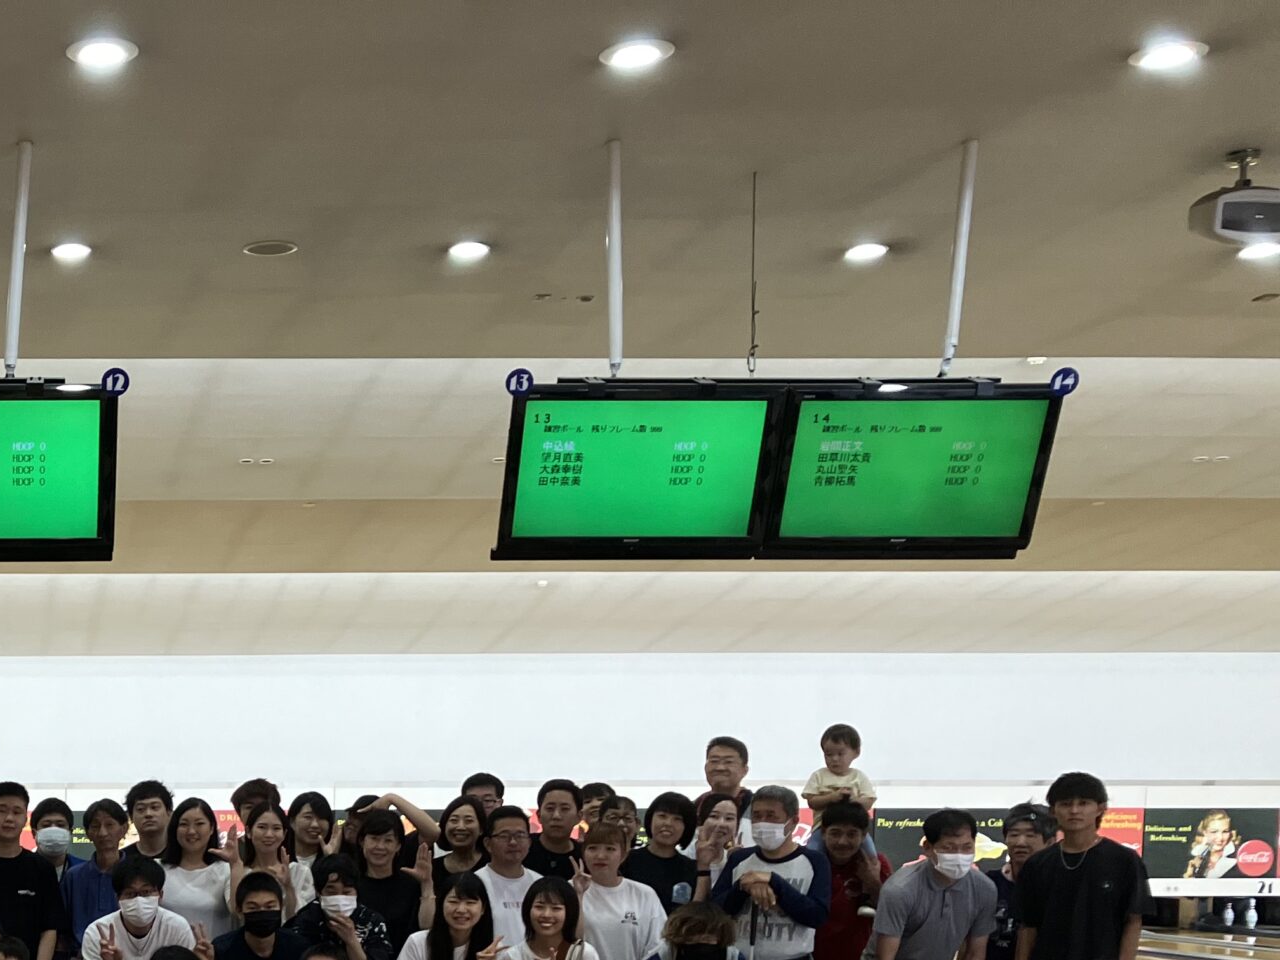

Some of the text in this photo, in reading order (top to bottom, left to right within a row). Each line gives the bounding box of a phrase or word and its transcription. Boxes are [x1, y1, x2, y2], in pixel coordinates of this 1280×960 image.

[106, 373, 125, 391] 12
[509, 374, 529, 391] 13
[1053, 373, 1075, 391] 14
[533, 413, 551, 424] 13
[813, 413, 831, 424] 14
[877, 818, 893, 829] Play
[895, 818, 925, 830] refreshe
